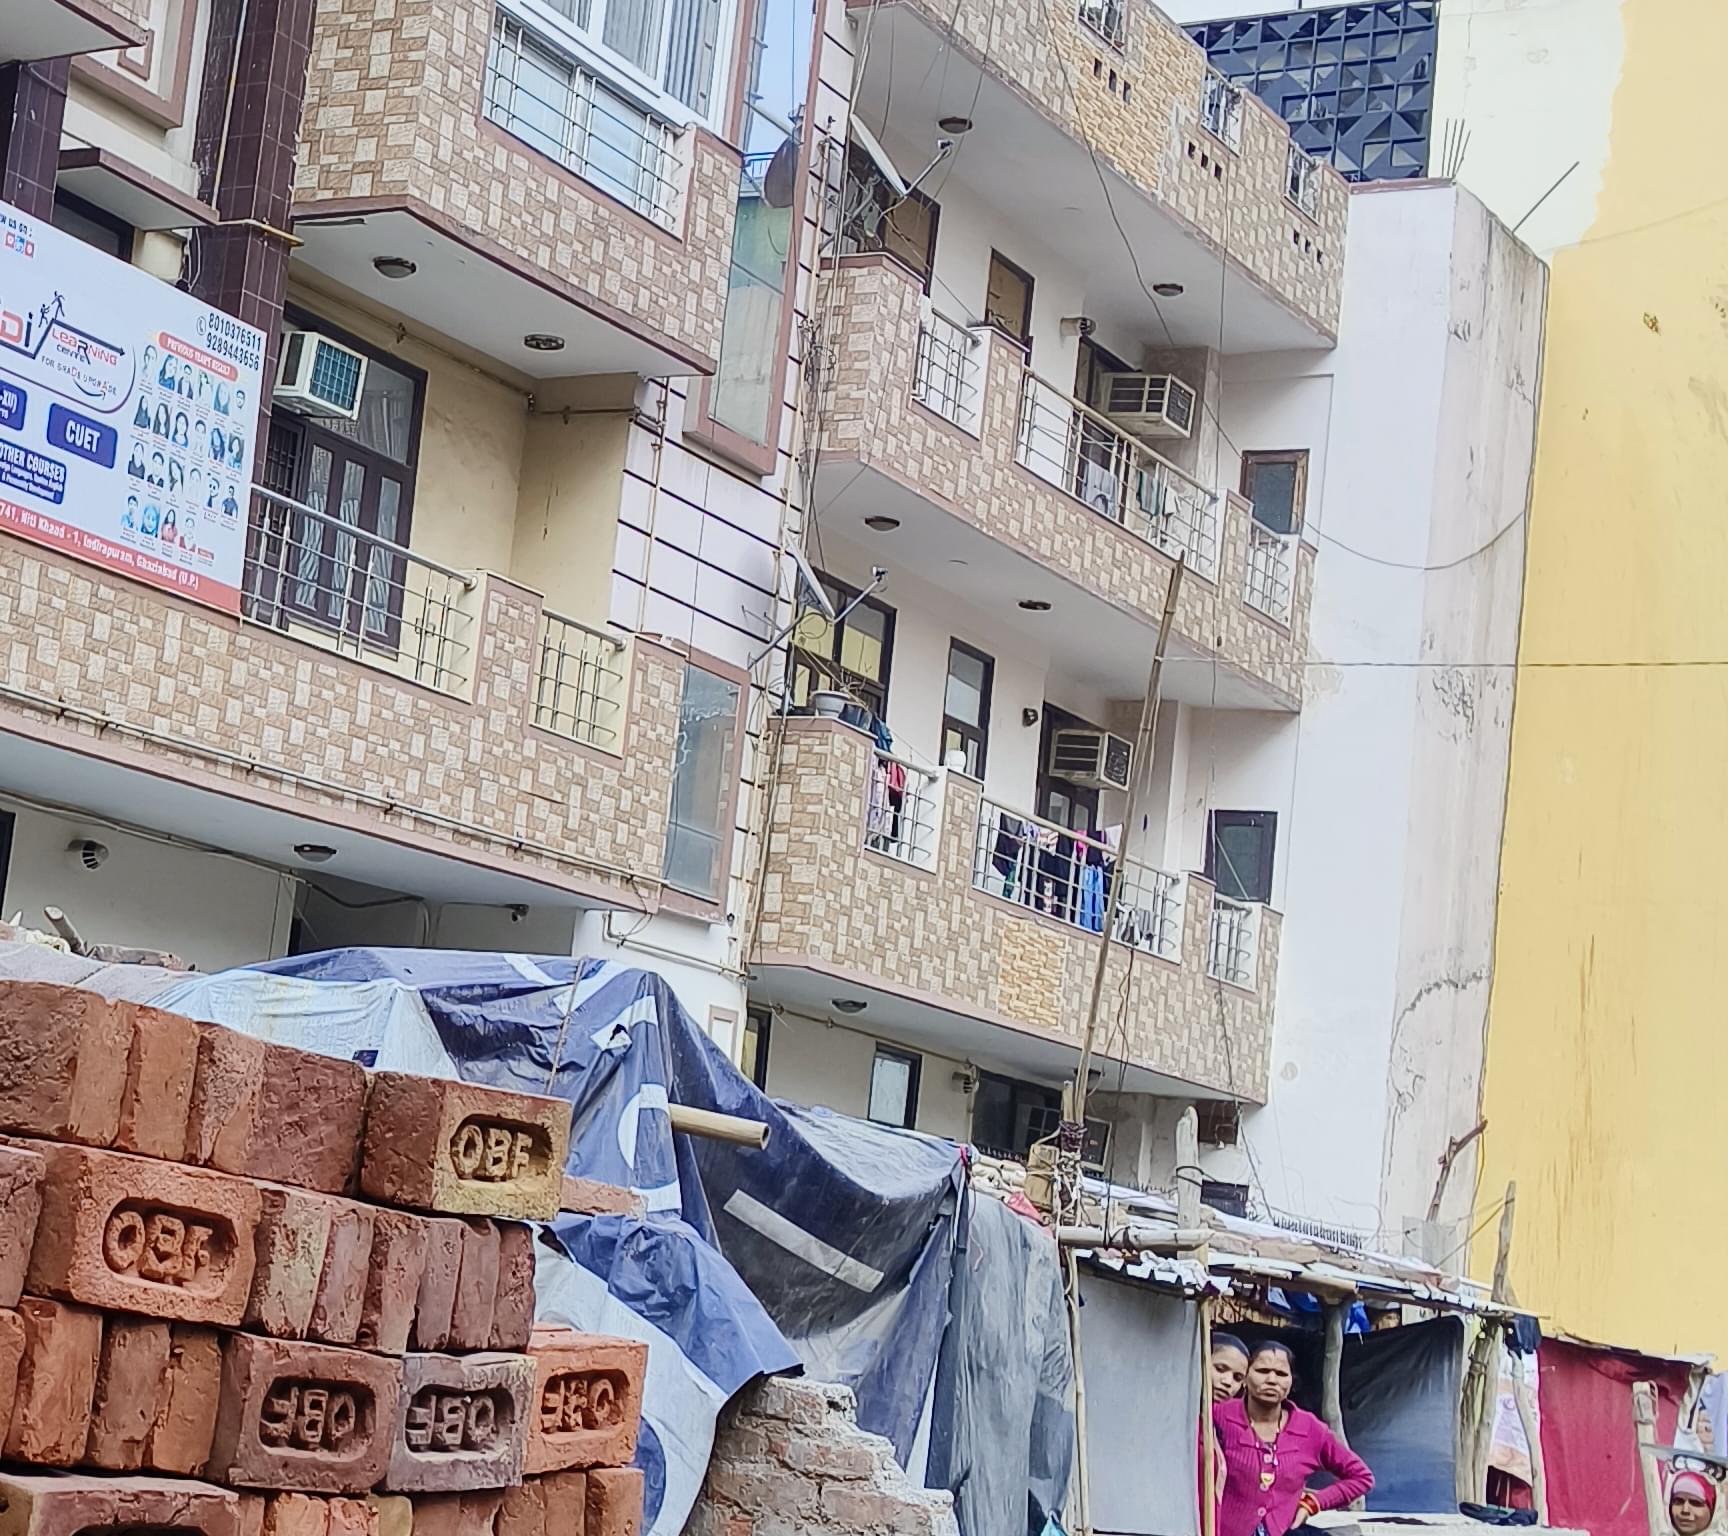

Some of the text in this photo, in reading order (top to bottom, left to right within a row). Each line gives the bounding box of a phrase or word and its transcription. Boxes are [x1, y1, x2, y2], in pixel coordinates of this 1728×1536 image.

[209, 313, 261, 352] 8010376511
[65, 419, 101, 453] CUET
[26, 454, 65, 483] COURSES
